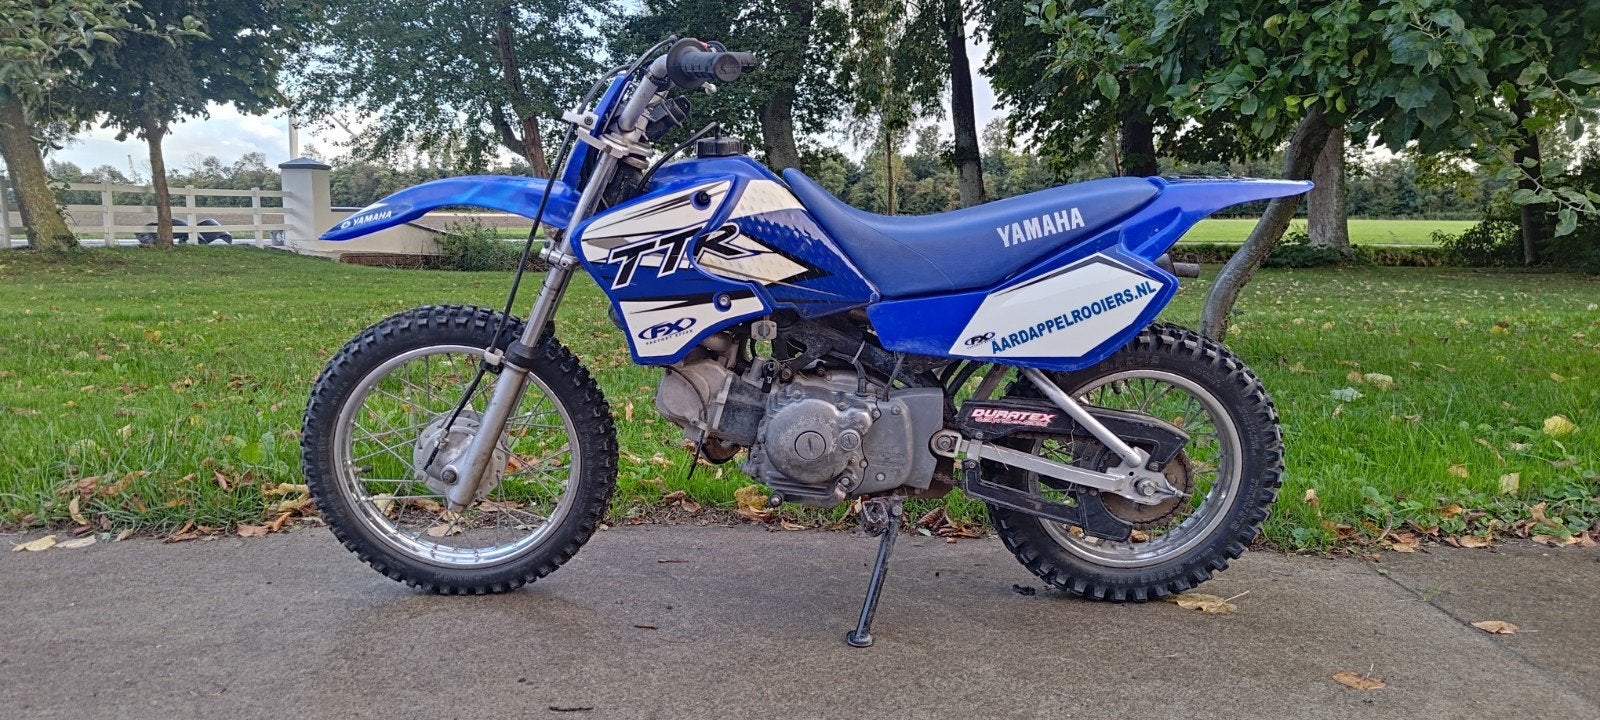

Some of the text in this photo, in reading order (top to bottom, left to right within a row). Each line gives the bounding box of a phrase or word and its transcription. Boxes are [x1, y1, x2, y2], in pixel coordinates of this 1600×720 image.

[354, 210, 392, 225] YAMAHA
[996, 207, 1085, 248] YAMAHA
[608, 222, 756, 290] TTR
[991, 281, 1156, 355] AARDAPPELROOIERS.NL
[971, 408, 1056, 422] DURATEX
